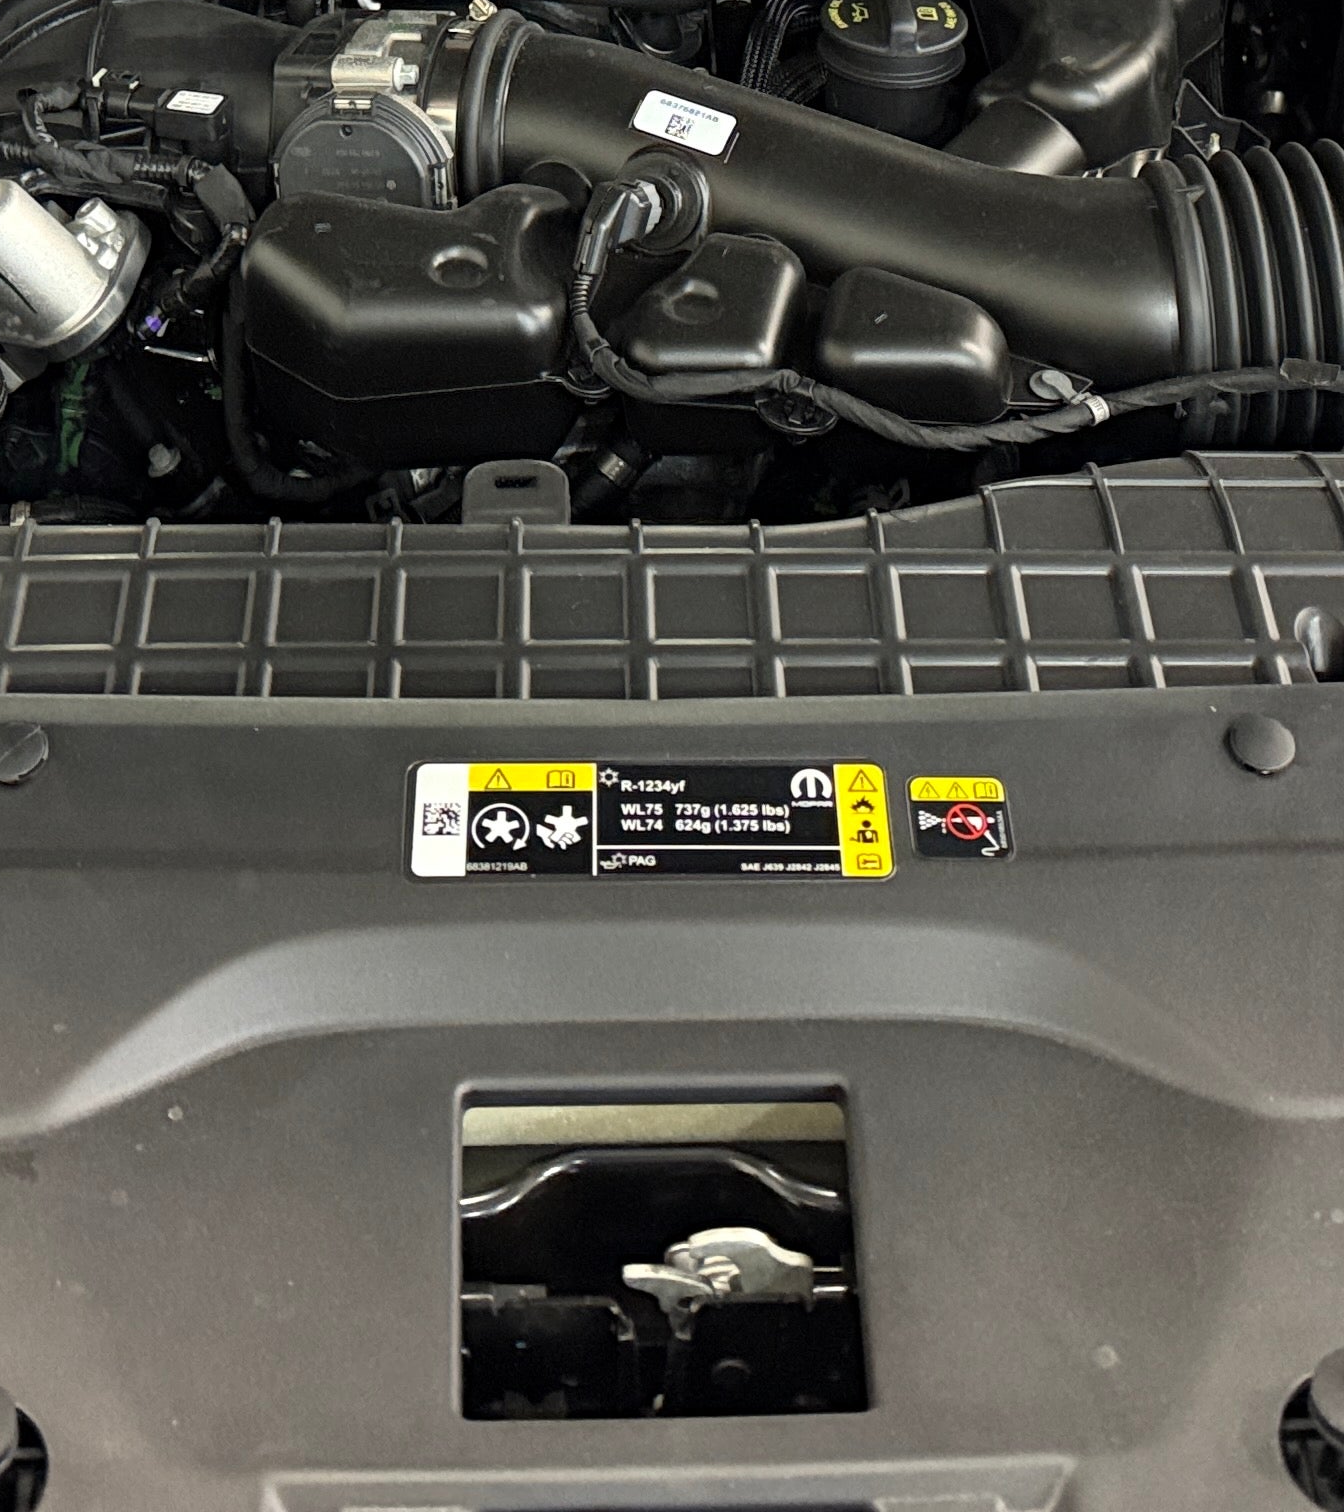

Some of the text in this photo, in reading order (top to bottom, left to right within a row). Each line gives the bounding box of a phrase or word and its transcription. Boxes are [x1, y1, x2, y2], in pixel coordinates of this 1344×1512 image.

[620, 780, 686, 795] R-1234yf
[791, 800, 834, 808] MOPAR
[621, 803, 790, 819] WL75 737g (1.625 lbs)
[621, 819, 791, 834] WL74 624g (1.375 lbs)
[628, 855, 656, 867] PAG
[740, 862, 761, 872] SAE
